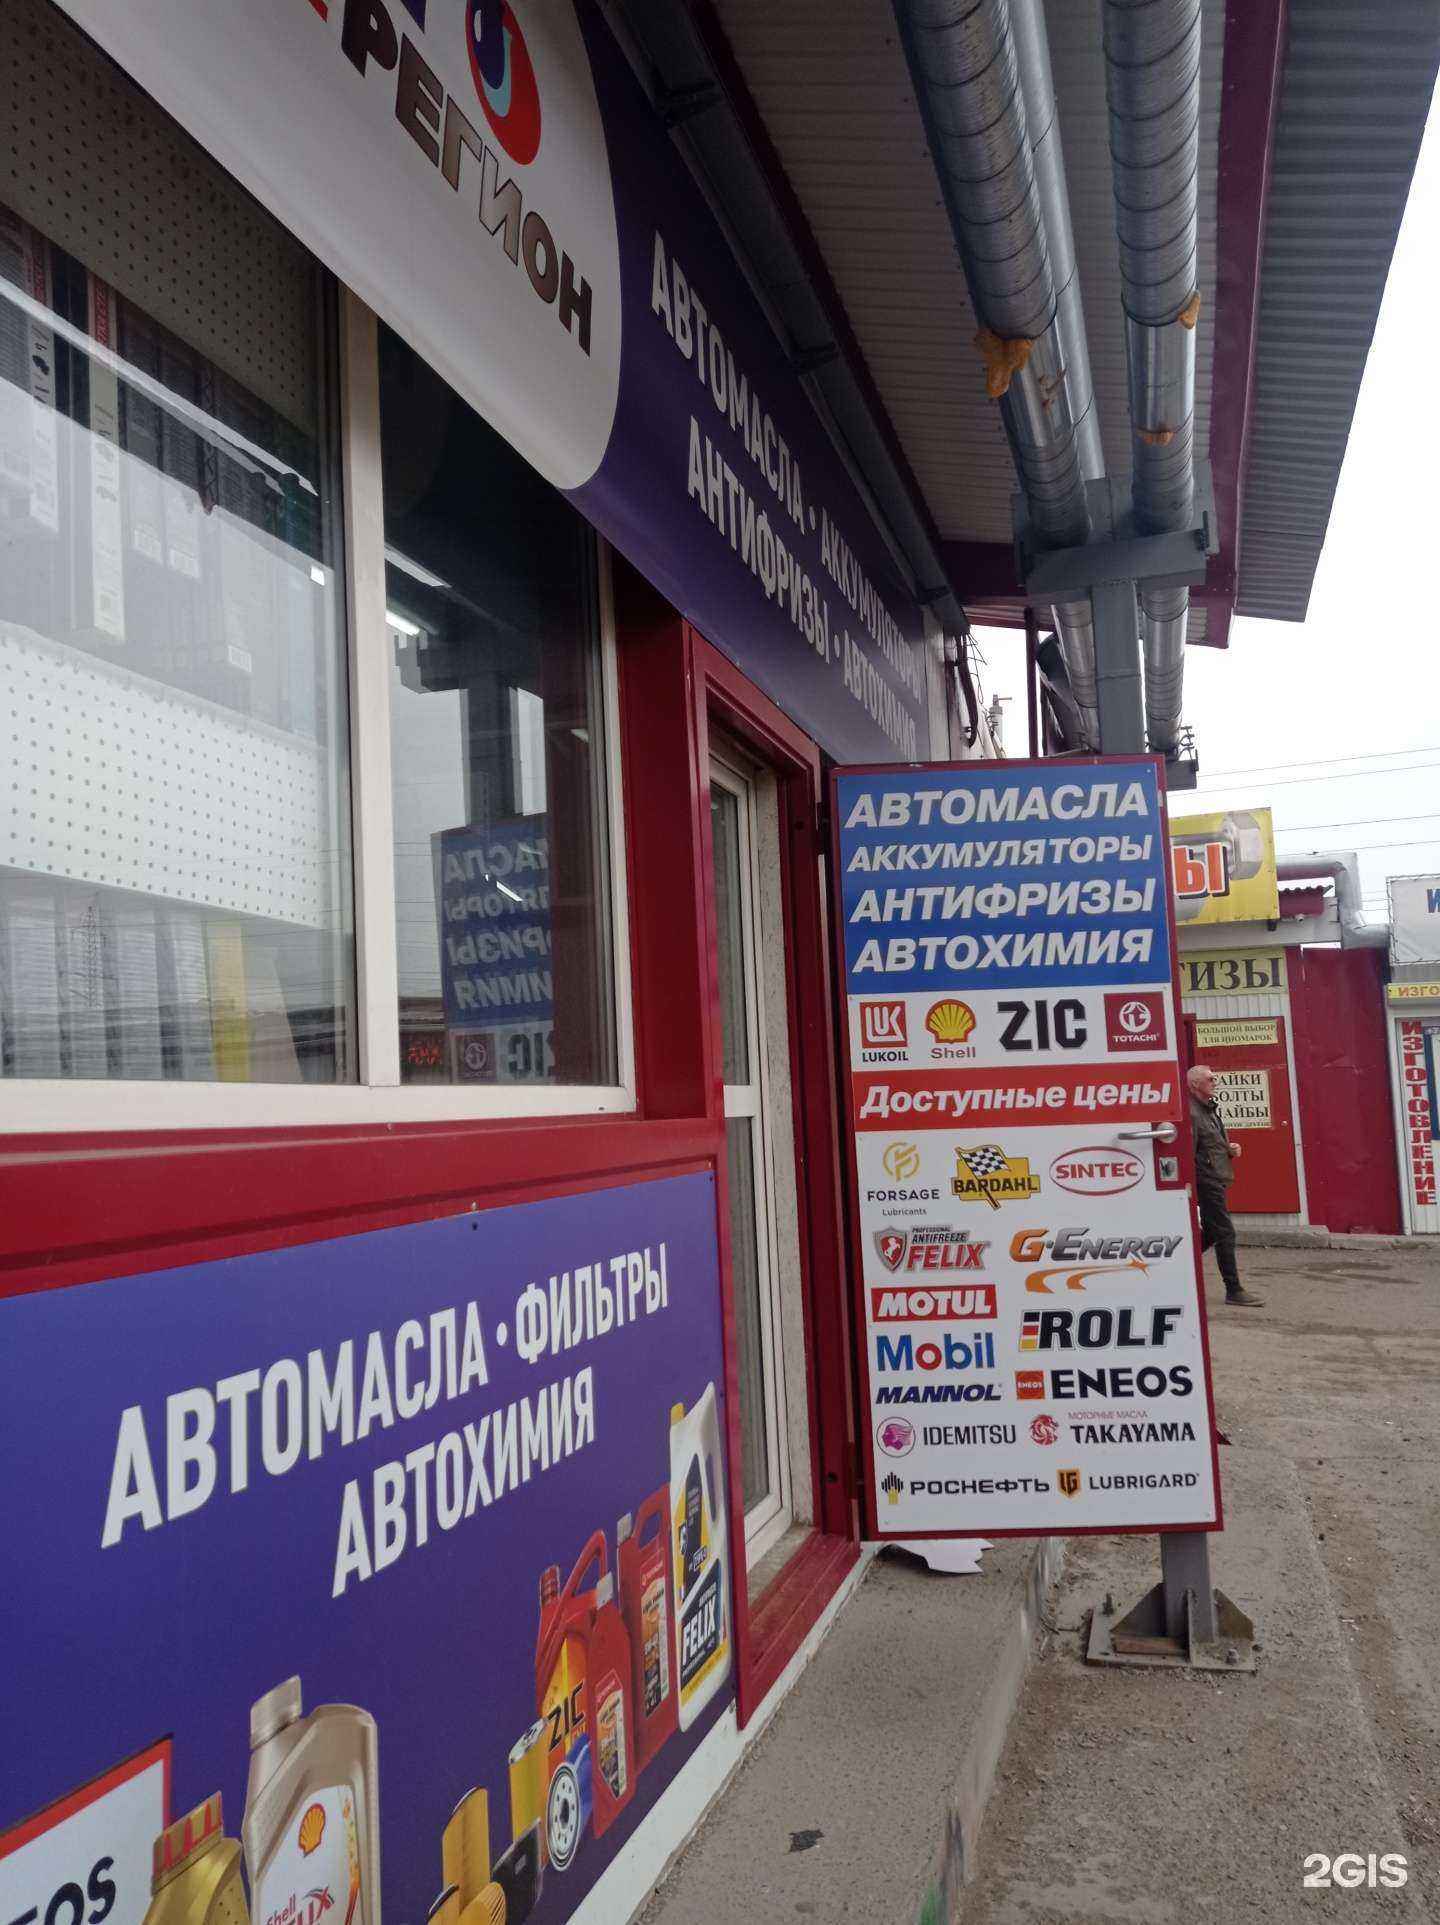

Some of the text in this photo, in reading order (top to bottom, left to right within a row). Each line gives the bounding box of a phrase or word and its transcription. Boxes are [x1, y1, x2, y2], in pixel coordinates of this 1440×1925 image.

[341, 0, 592, 357] РЕГИОН
[651, 229, 922, 704] АВТОМАСЛА АККУМУЛЯТОРЫ
[687, 415, 917, 761] АНТИФРИЗЫ АВТОХИМИЯ
[844, 782, 1149, 828] АВТОМАСЛА
[846, 835, 1152, 872] АККУМУЛЯТОРЫ
[849, 879, 1156, 923] АНТИФРИЗЫ
[852, 928, 1153, 973] АВТОХИМИЯ
[1179, 957, 1283, 991] ИЗЫ
[997, 999, 1087, 1050] ZIC
[1112, 1033, 1158, 1043] TOTACHI
[862, 1049, 909, 1062] LUKOIL
[931, 1047, 976, 1059] Shell
[860, 1082, 1171, 1118] Доступные цены
[954, 1175, 1039, 1194] BARDAHL
[1055, 1162, 1139, 1180] SINTEC
[867, 1188, 940, 1202] FORSAGE
[882, 1207, 927, 1217] Lubricants
[912, 1232, 967, 1244] ANTIFREEZE
[907, 1243, 985, 1269] FELIX
[877, 1289, 993, 1318] MOTUL
[1039, 1308, 1182, 1349] ROLF
[876, 1332, 995, 1372] Mobil
[100, 1242, 670, 1549] АВТОМАСЛА ФИЛЬТРЫ
[876, 1384, 999, 1404] MANNOL
[1051, 1365, 1193, 1399] ENEOS
[923, 1424, 1017, 1446] IDEMITSU
[1070, 1422, 1196, 1445] TAKAYAMA
[331, 1366, 595, 1599] АВТОХИМИЯ
[910, 1477, 1049, 1495] РОСНЕФТЬ
[1090, 1473, 1197, 1490] LUBRIGARD
[683, 1595, 717, 1665] FELIX
[548, 1680, 586, 1752] ZIC
